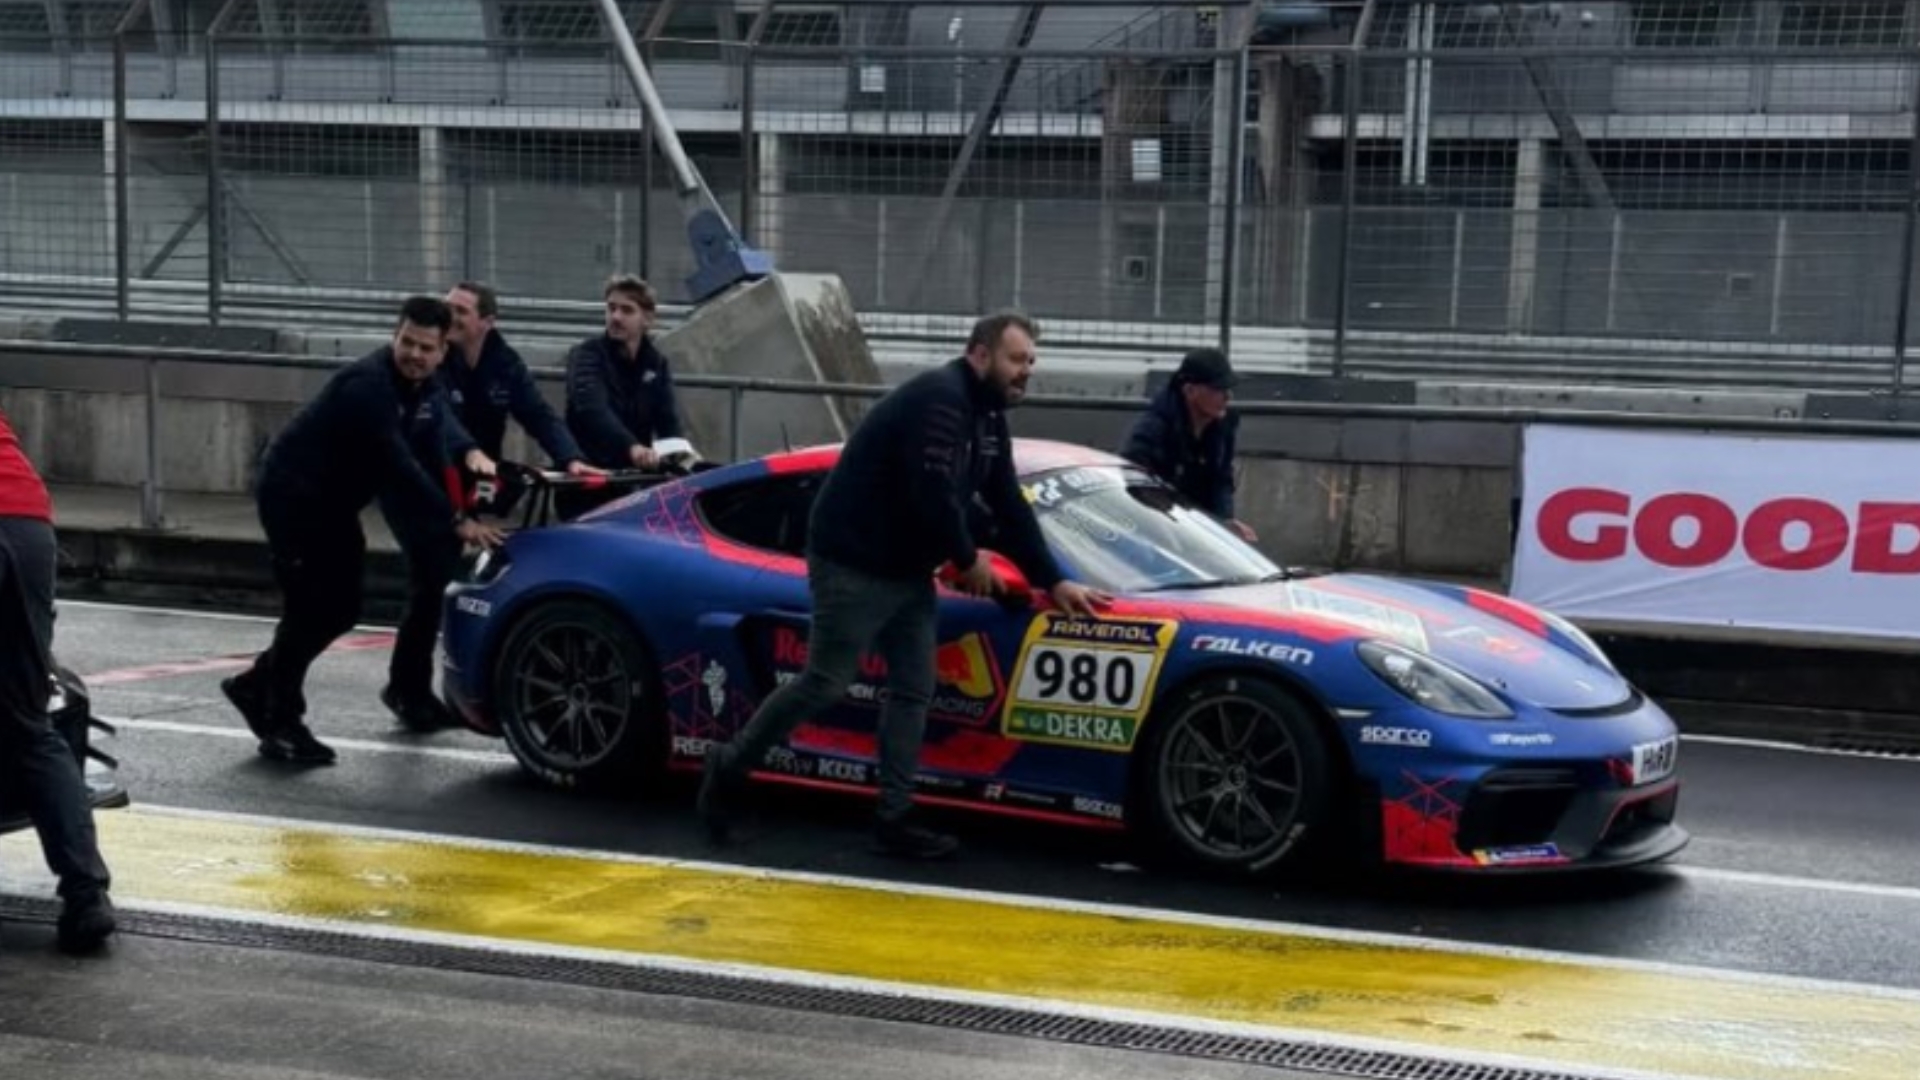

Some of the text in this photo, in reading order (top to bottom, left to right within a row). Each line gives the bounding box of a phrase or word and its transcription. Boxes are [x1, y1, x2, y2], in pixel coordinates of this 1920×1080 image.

[1536, 486, 1920, 574] GOOD
[774, 627, 811, 665] Re
[1191, 635, 1315, 666] FALKEN
[1034, 650, 1135, 706] 980
[932, 695, 985, 717] ACING
[1046, 712, 1125, 743] DEKRA
[1359, 725, 1432, 746] sparco
